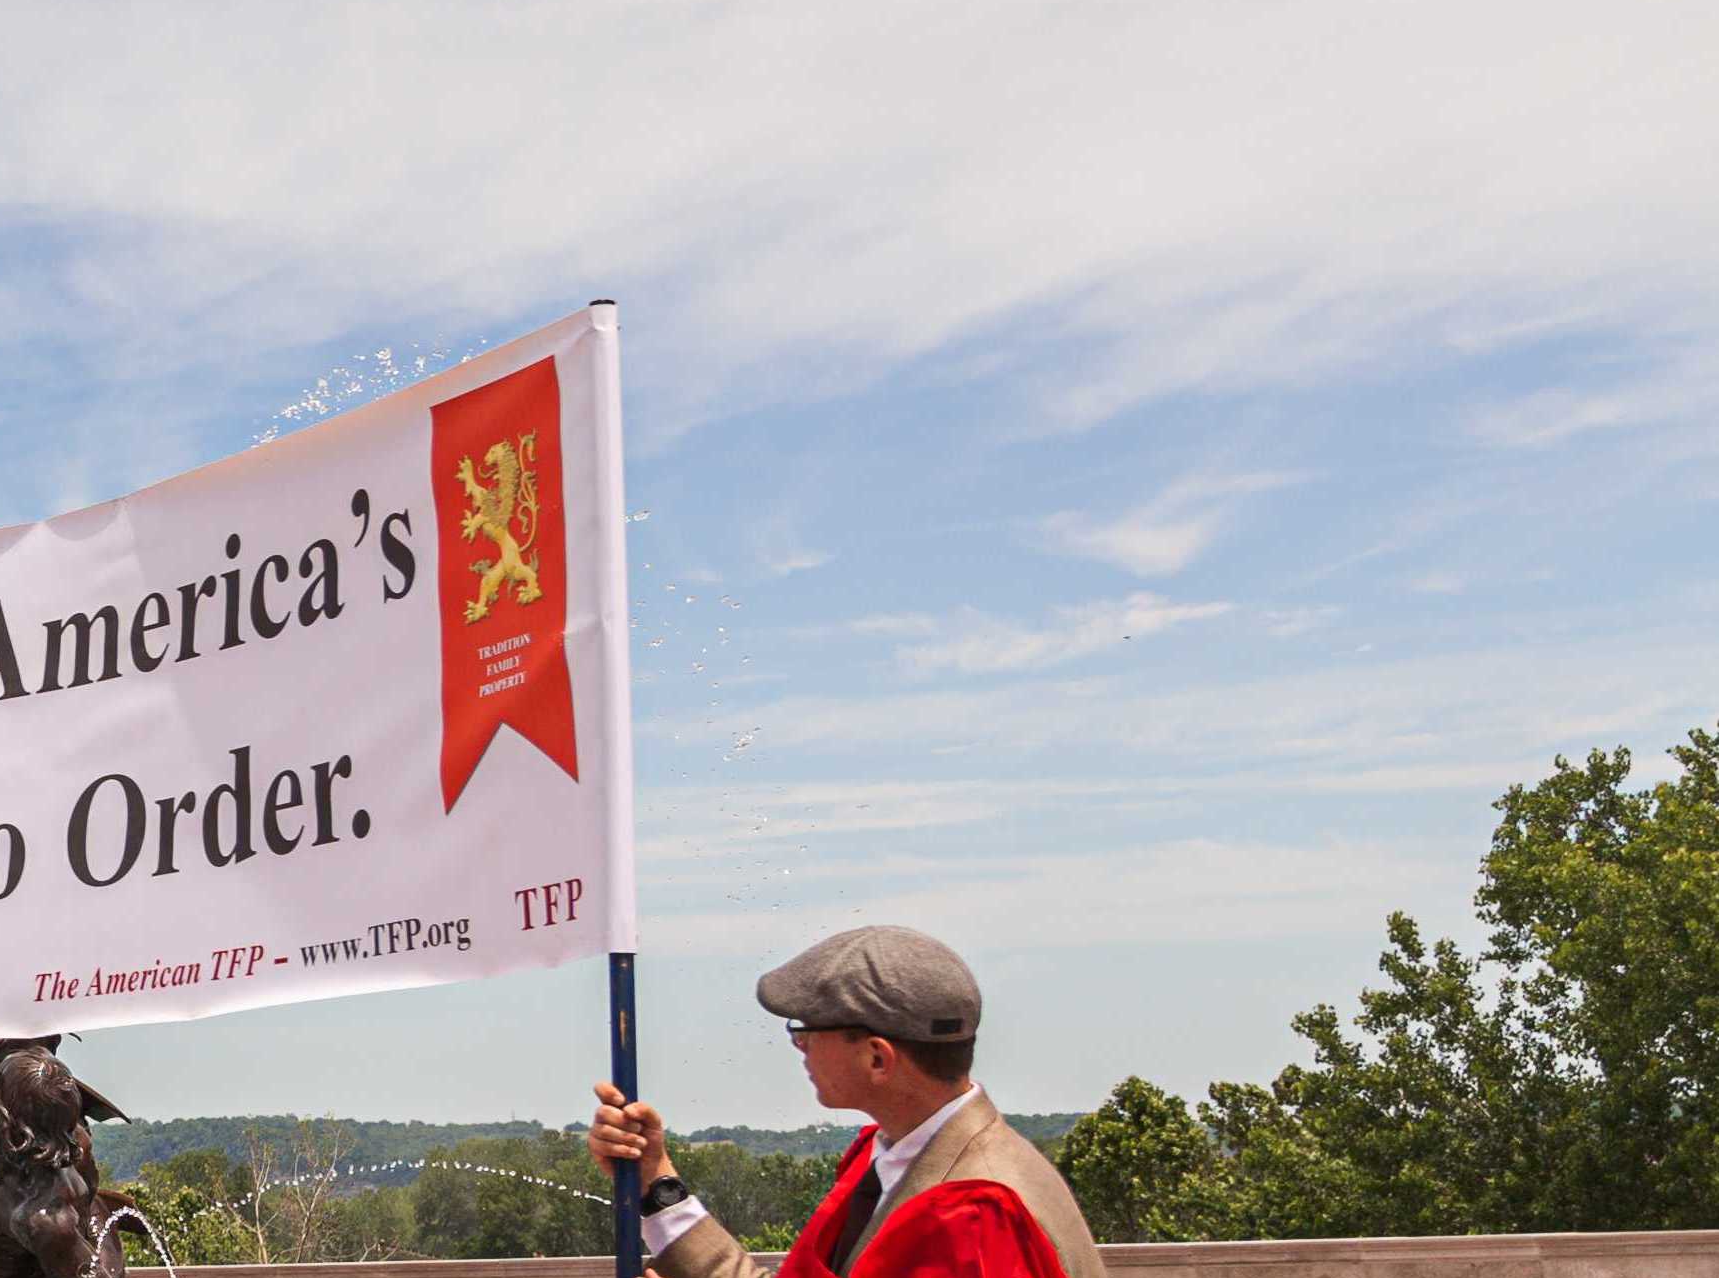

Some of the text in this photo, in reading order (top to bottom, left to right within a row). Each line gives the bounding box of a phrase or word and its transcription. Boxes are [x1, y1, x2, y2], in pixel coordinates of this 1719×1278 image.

[477, 633, 531, 660] TRADITION
[486, 655, 521, 676] FAMILY
[479, 671, 527, 698] PROPERTY
[67, 745, 371, 888] Order.
[514, 877, 583, 932] TFP
[33, 970, 80, 1002] The
[84, 959, 201, 997] American
[210, 944, 265, 981] TFP
[299, 917, 472, 967] www.TFP.org
